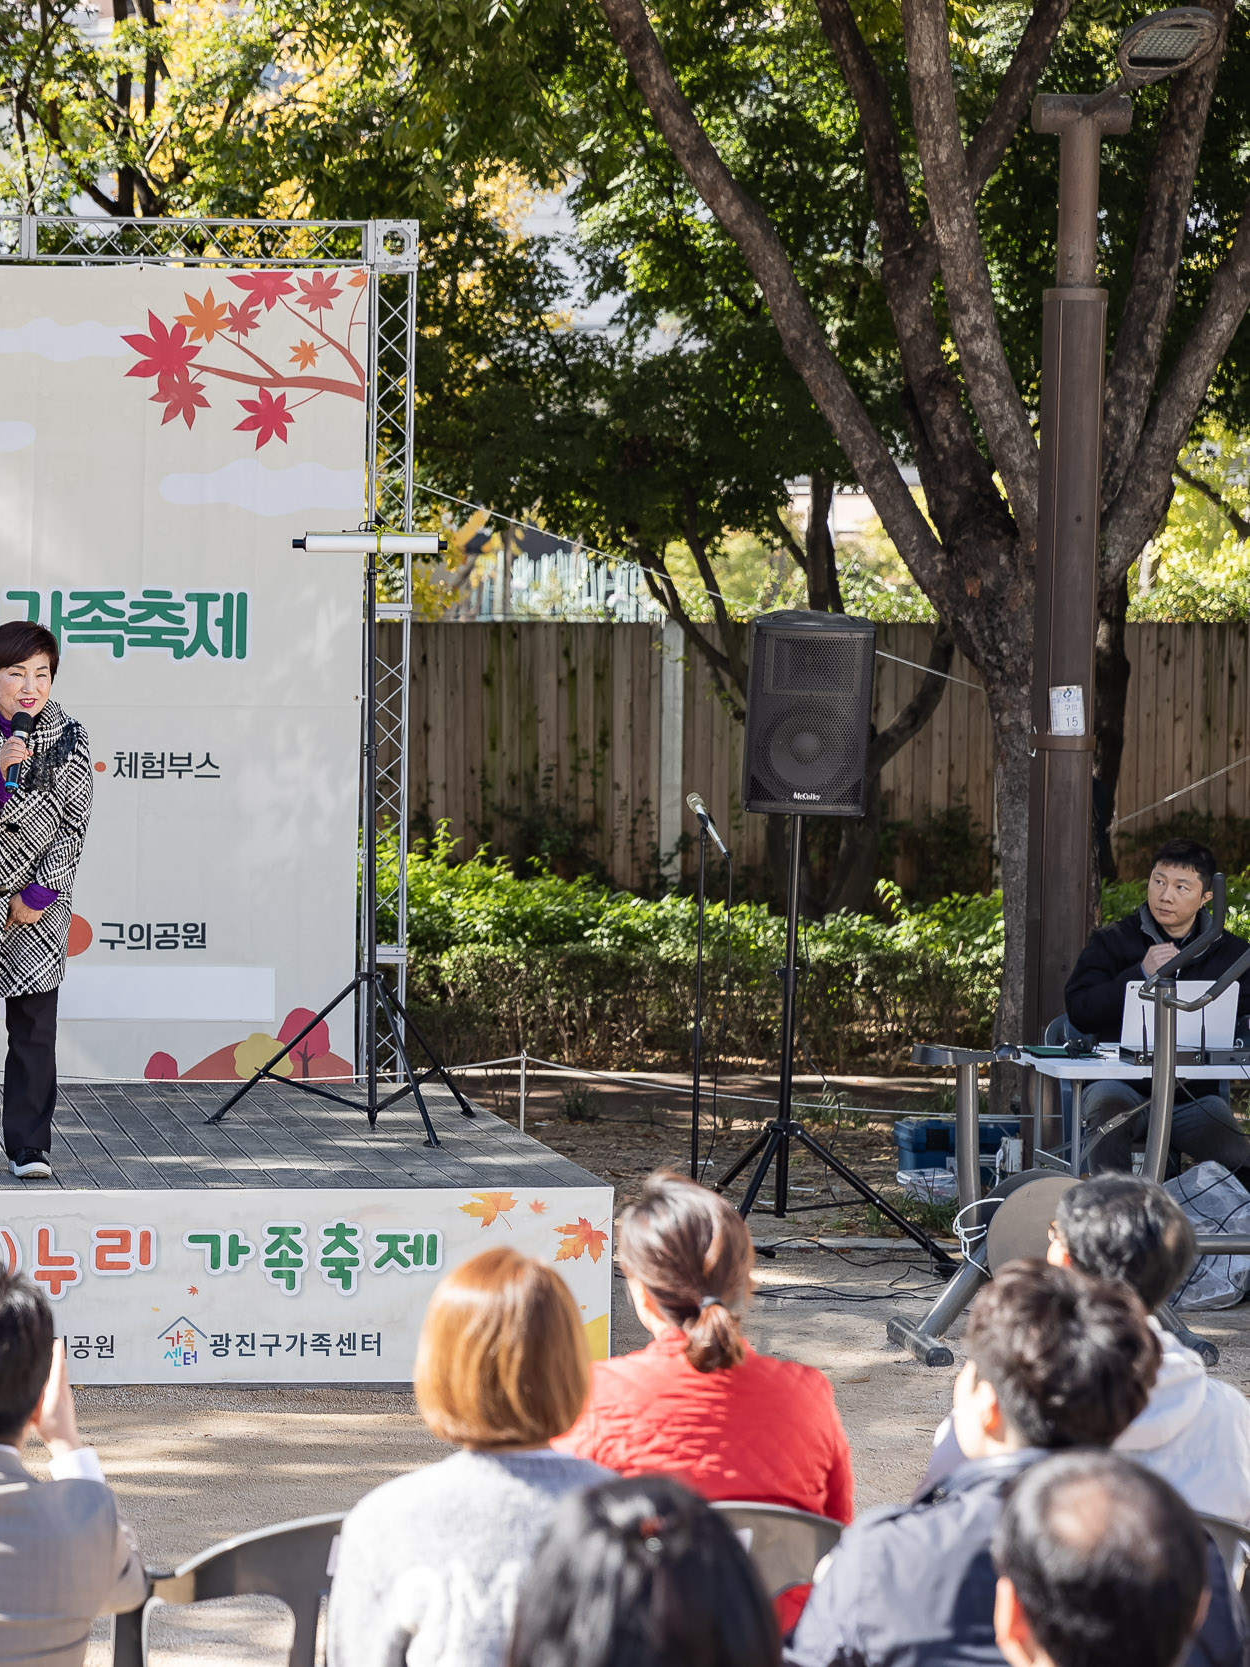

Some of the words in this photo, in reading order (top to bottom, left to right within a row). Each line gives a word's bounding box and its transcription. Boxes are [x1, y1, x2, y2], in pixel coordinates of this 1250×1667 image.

[6, 590, 249, 661] 가족축제
[1066, 716, 1079, 728] 15
[112, 751, 221, 780] 체험부스
[99, 922, 207, 951] 구의공원
[187, 1223, 438, 1292] 가족축제
[165, 1330, 196, 1351] 가족
[209, 1332, 382, 1358] 광진구가족센터
[163, 1347, 198, 1367] 센터
